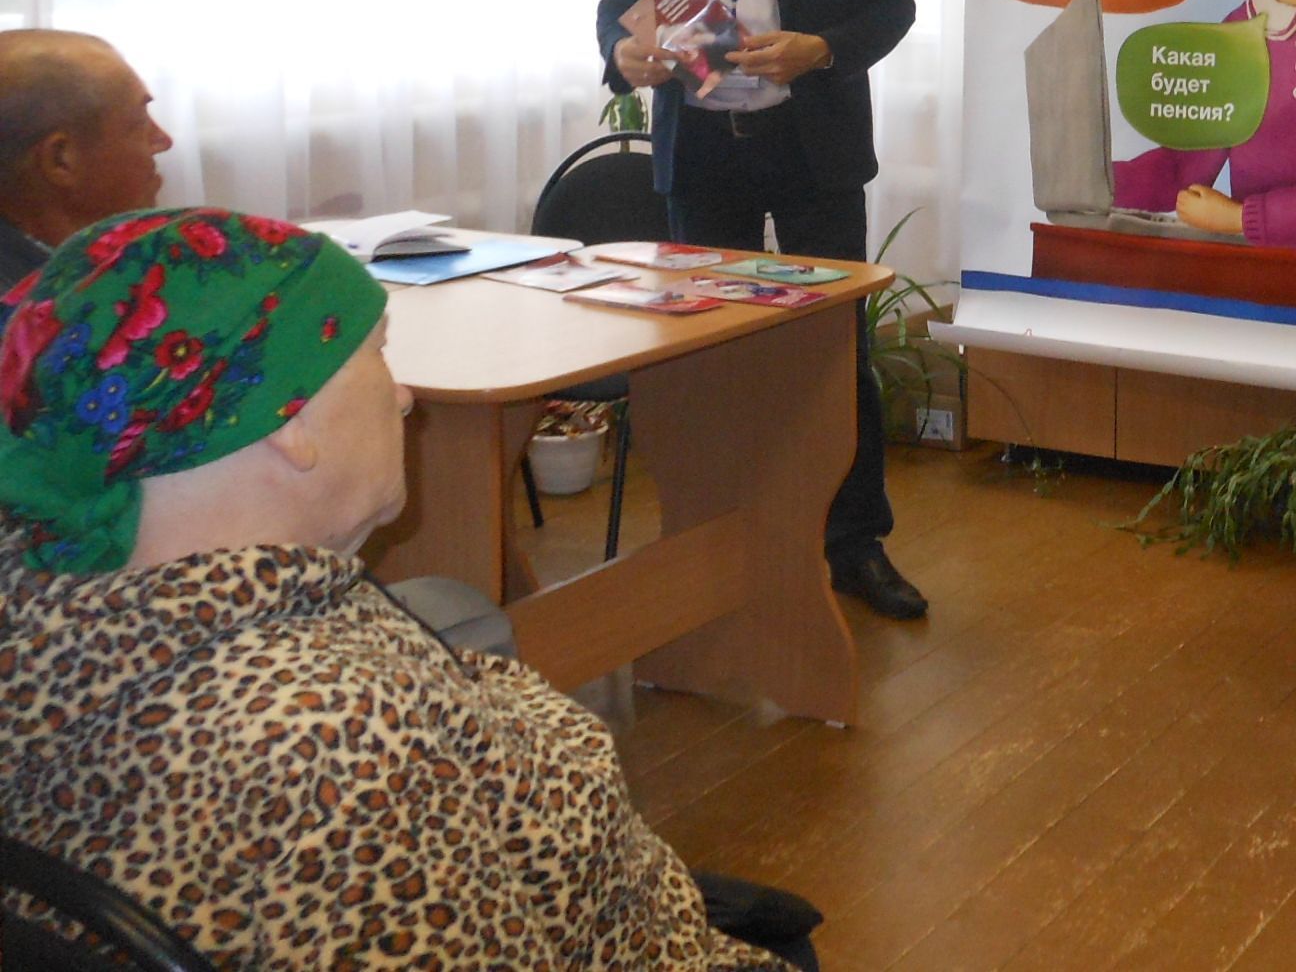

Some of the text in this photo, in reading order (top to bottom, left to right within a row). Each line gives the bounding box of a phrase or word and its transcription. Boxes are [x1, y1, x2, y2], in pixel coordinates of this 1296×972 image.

[1151, 45, 1217, 67] Какая
[1150, 72, 1211, 95] будет
[1149, 102, 1236, 123] пенсия?
